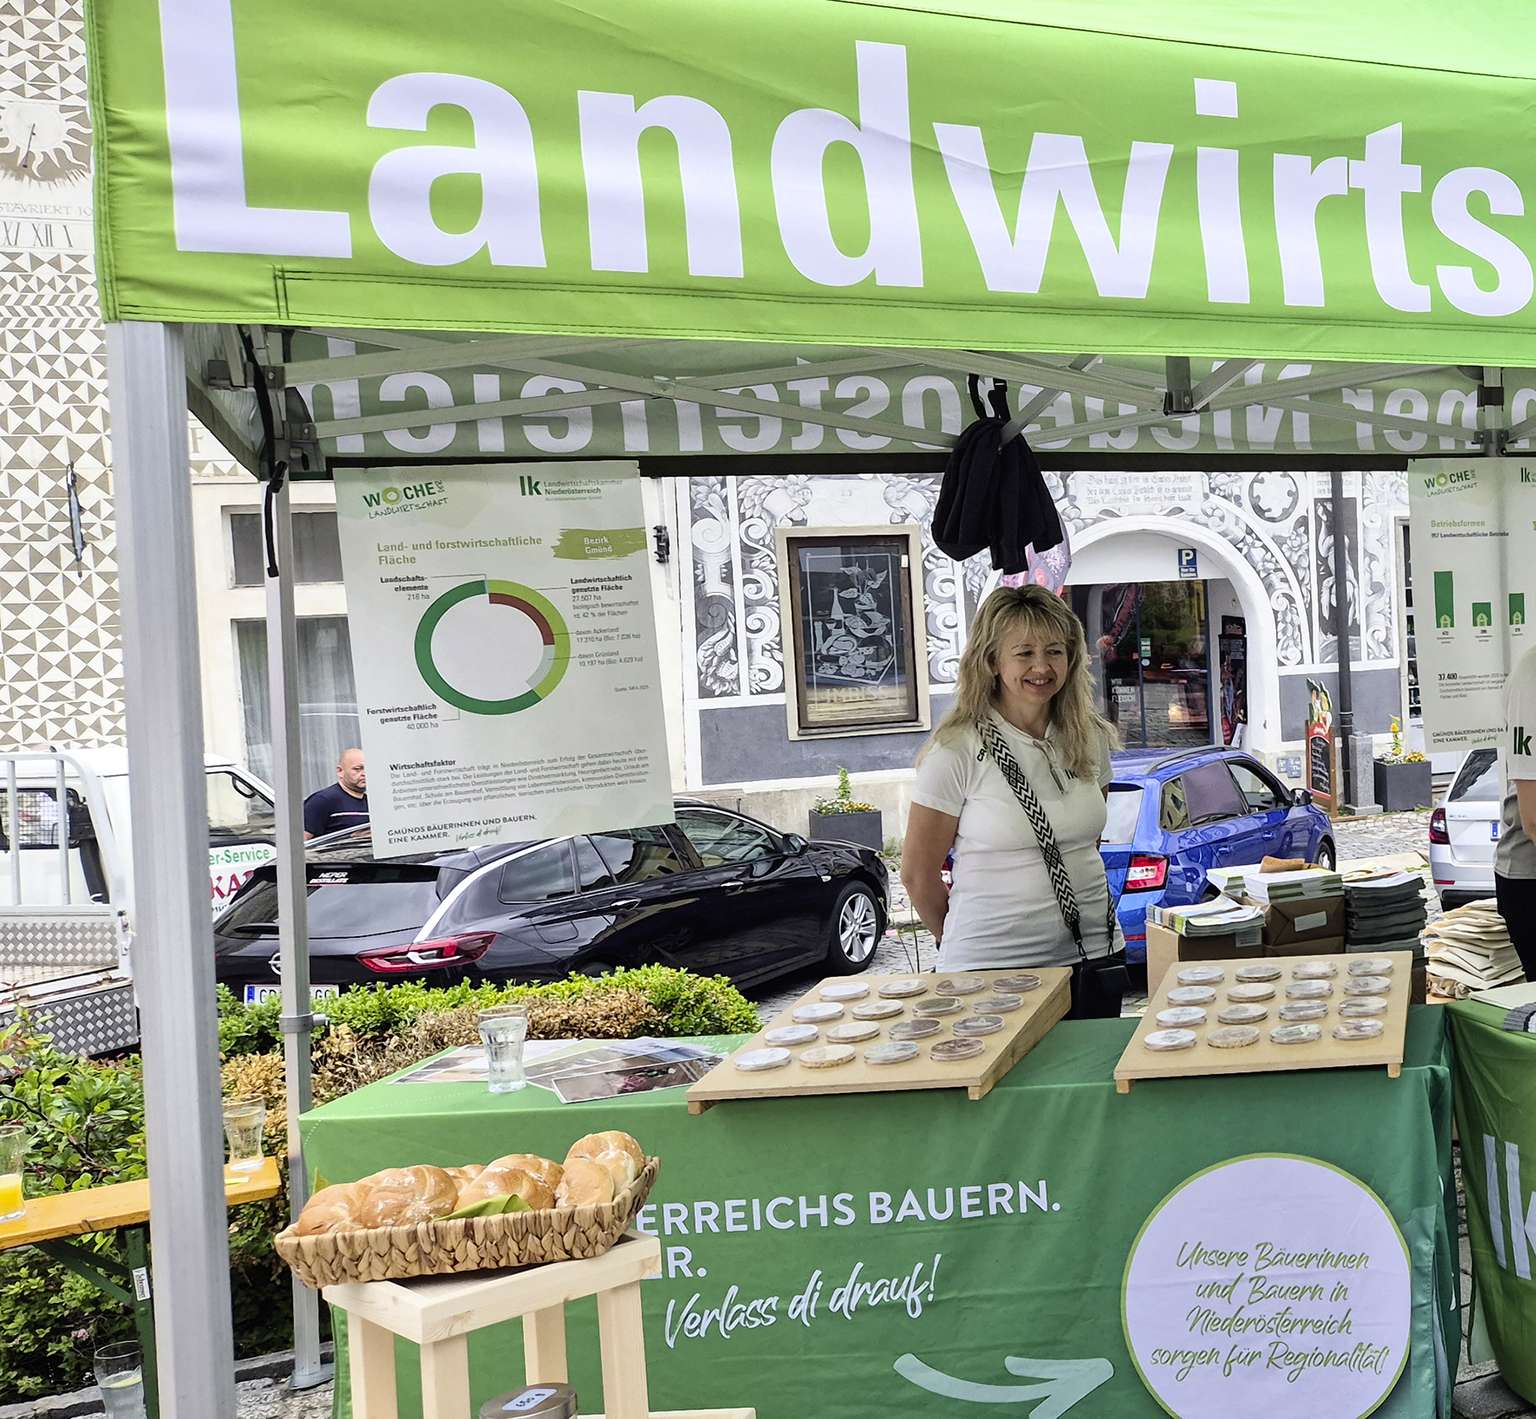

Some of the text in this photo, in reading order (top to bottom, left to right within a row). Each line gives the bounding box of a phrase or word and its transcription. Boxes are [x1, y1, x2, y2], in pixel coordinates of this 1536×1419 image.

[1424, 470, 1470, 489] WOCHE
[1520, 467, 1531, 483] lk
[519, 475, 542, 496] lk
[363, 482, 436, 508] WOCHE
[377, 536, 542, 552] Land- und forstwirtschaftliche
[584, 536, 609, 545] Bezirk
[378, 554, 416, 565] Fläche
[1181, 550, 1194, 566] P
[570, 574, 633, 584] Landwirtschaftlich
[366, 703, 437, 715] Forstwirtschaftlich
[413, 713, 438, 721] Fläche
[1513, 726, 1532, 756] lk
[389, 759, 456, 771] Wirtschaftsfaktor
[482, 817, 501, 826] UND
[388, 836, 409, 845] EINE
[869, 1178, 1063, 1225] BAUERN.
[1176, 1241, 1370, 1271] Unsere Bäuerinnen
[1195, 1272, 1349, 1306] und Bauern in
[665, 1252, 944, 1350] Verlass di drauf!
[1186, 1305, 1353, 1338] Niederösterreich
[1150, 1341, 1390, 1383] sorgen für Regionalität!
